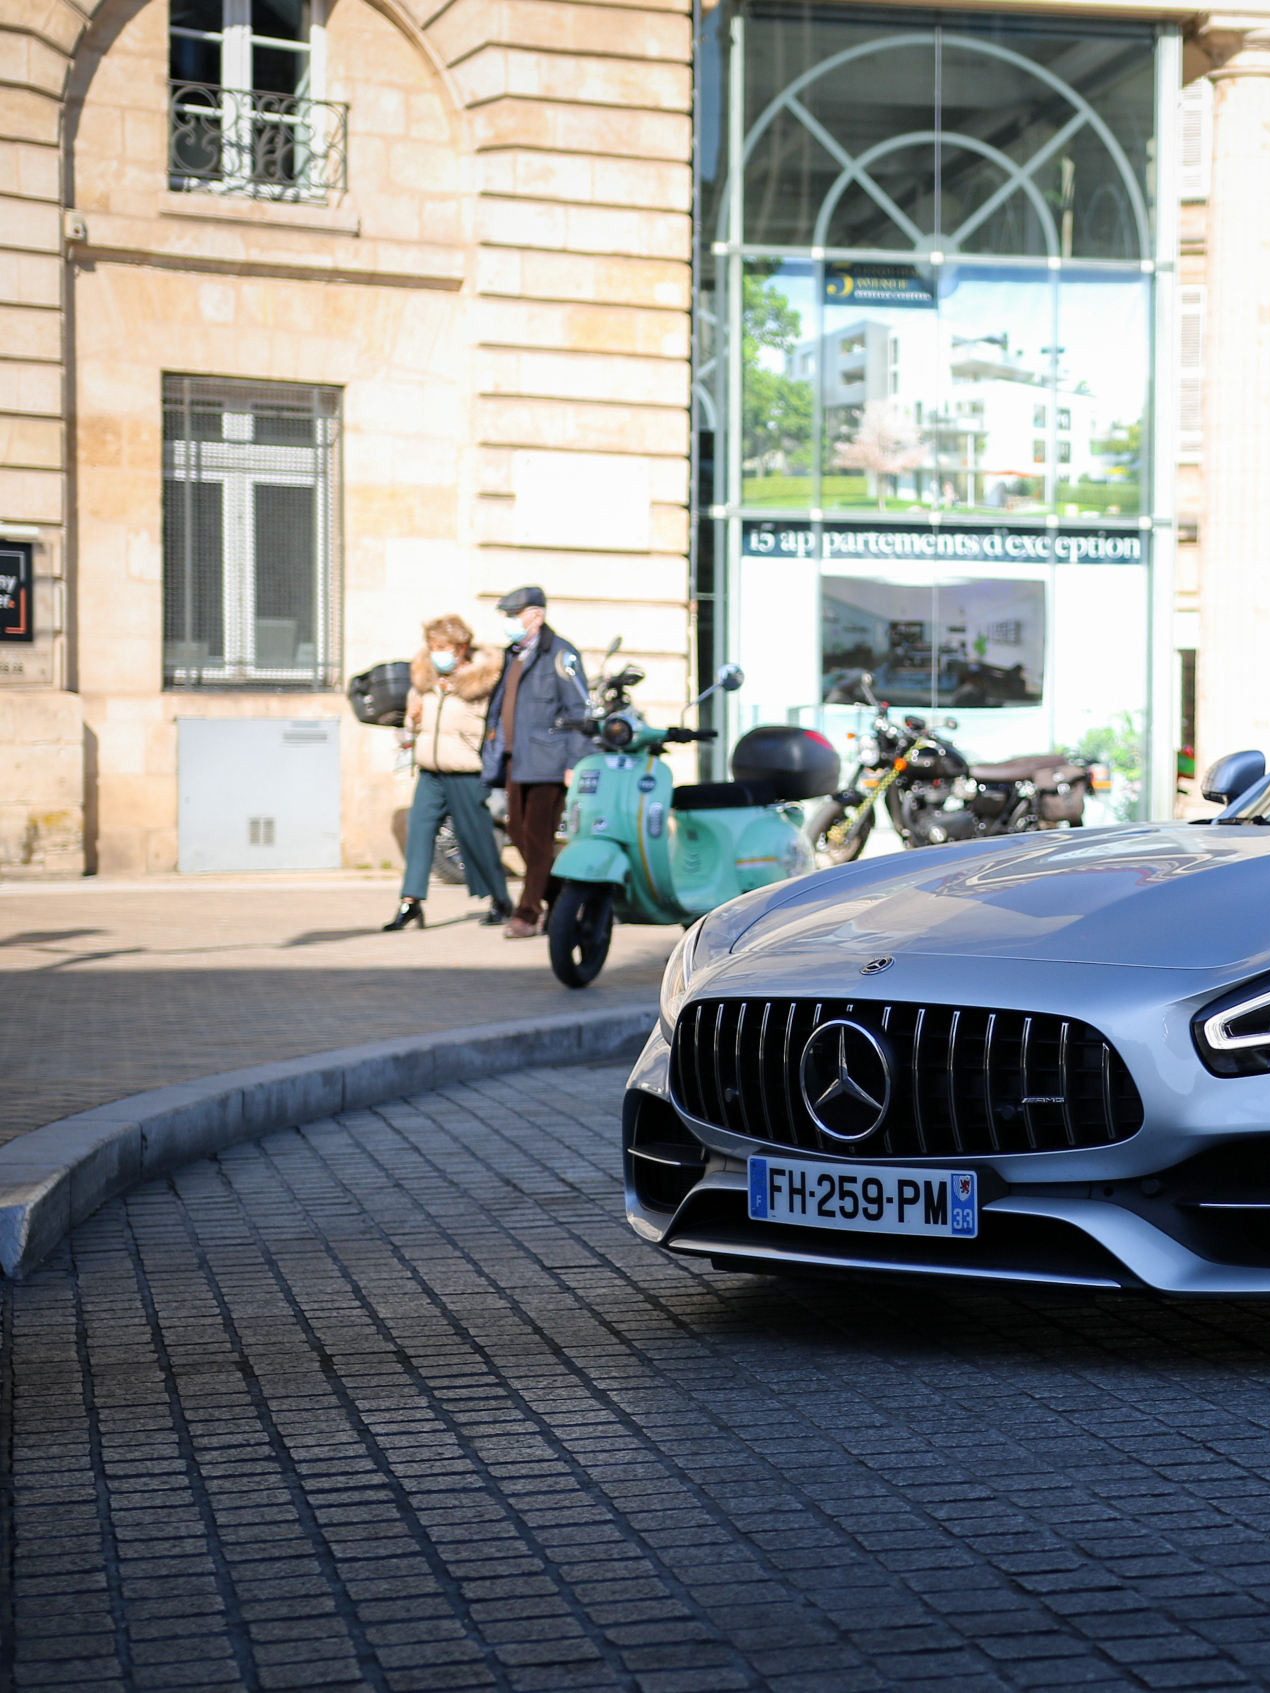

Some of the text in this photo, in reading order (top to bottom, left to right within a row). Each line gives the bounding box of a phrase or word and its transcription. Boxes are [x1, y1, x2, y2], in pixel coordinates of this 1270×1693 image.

[780, 530, 980, 559] appartements
[983, 528, 1141, 563] d'exception
[769, 1167, 948, 1226] FH-259-PM
[953, 1208, 974, 1230] 33
